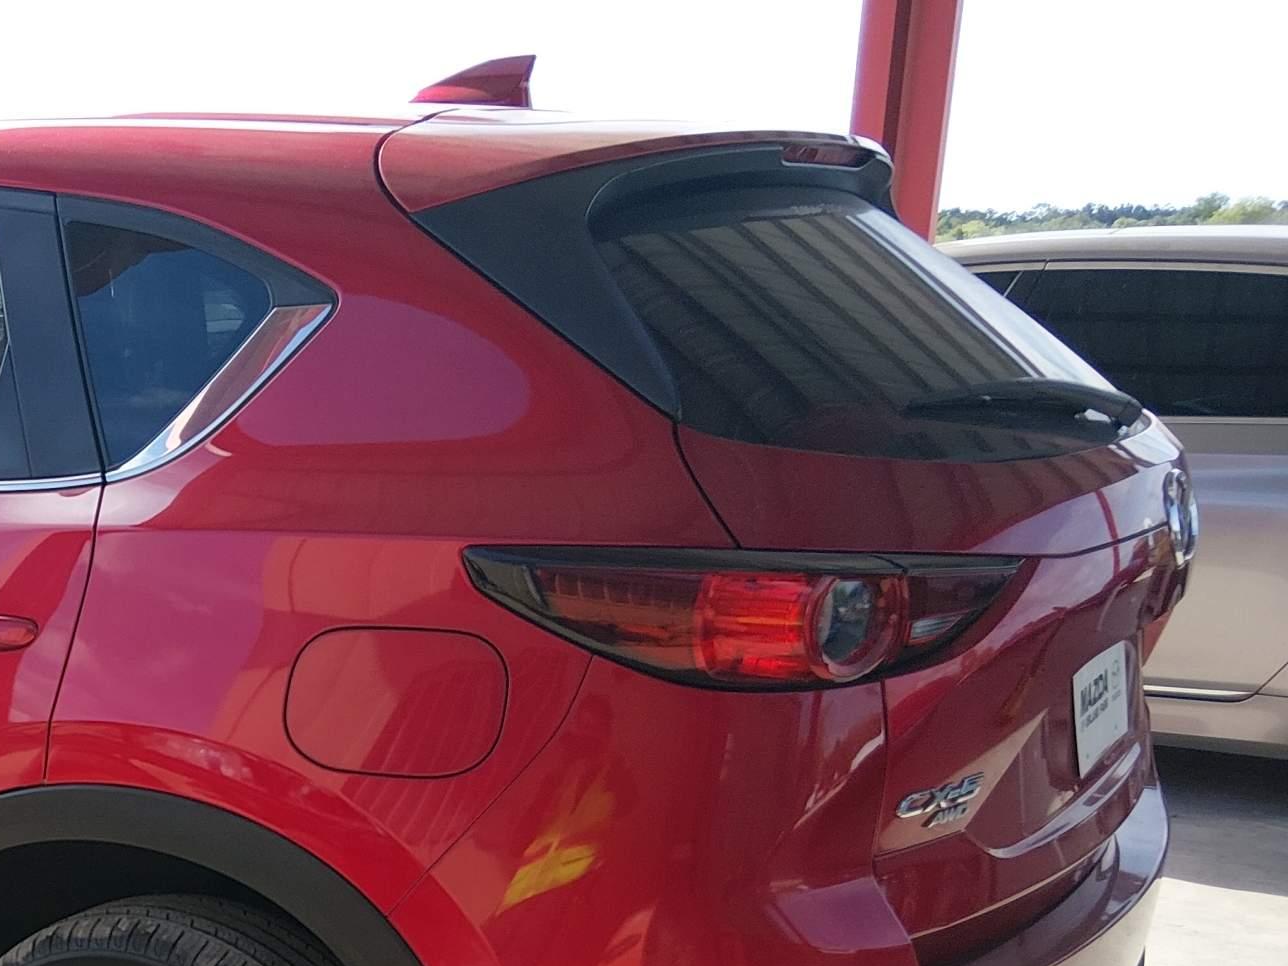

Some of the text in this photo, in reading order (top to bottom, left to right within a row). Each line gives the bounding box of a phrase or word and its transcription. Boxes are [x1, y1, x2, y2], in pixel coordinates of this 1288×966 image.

[1080, 667, 1109, 717] MAZDA
[895, 771, 985, 818] CX-5
[922, 801, 968, 828] AWD
